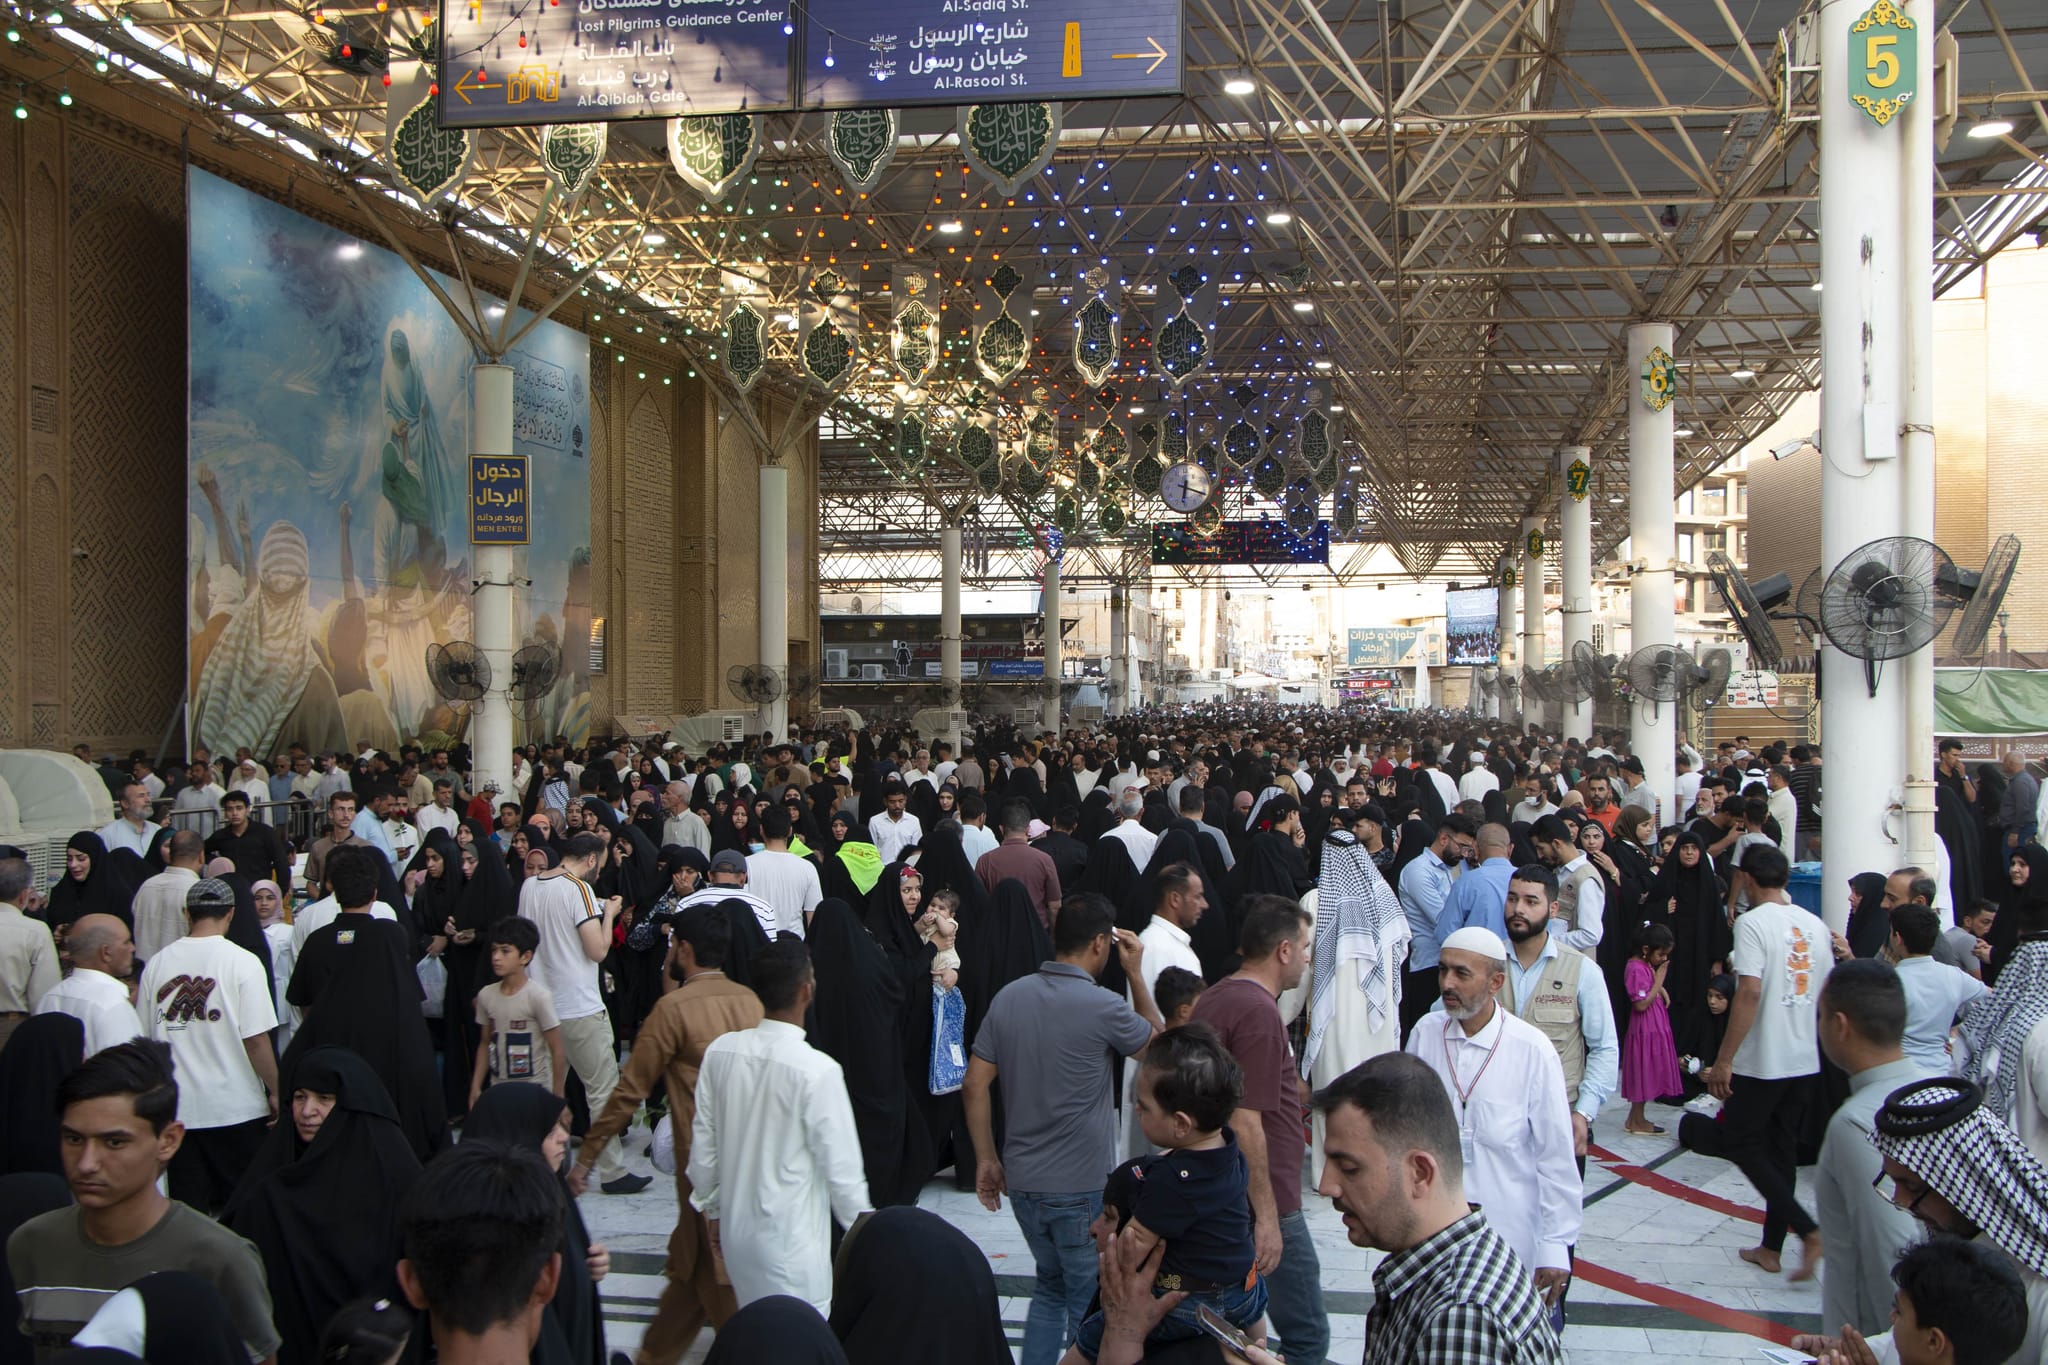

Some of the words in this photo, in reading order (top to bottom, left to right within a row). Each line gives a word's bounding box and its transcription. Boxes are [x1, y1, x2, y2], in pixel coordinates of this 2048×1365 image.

[578, 20, 604, 33] Lost
[608, 17, 661, 33] Pilgrims
[666, 13, 732, 28] Guidance
[736, 9, 784, 23] Center
[980, 19, 1029, 45] شارع
[909, 23, 974, 49] الرسول
[578, 39, 642, 64] القبلة
[643, 39, 675, 62] باب
[970, 47, 1028, 72] خيابان
[1865, 34, 1900, 89] 5
[909, 52, 964, 75] رسول
[577, 63, 626, 90] قبله
[633, 68, 671, 89] درب
[934, 74, 1005, 90] Al-Rasool
[1010, 72, 1028, 86] St.
[577, 91, 644, 107] Al-Qiblah
[649, 90, 686, 103] Gate
[1649, 366, 1668, 393] 6
[476, 463, 522, 483] دخول
[1572, 471, 1585, 490] 7
[476, 487, 523, 508] الرجال
[476, 513, 503, 524] مردانه
[477, 525, 495, 533] MEN
[496, 525, 523, 533] ENTER
[504, 514, 524, 524] ورود
[1532, 536, 1540, 550] 8
